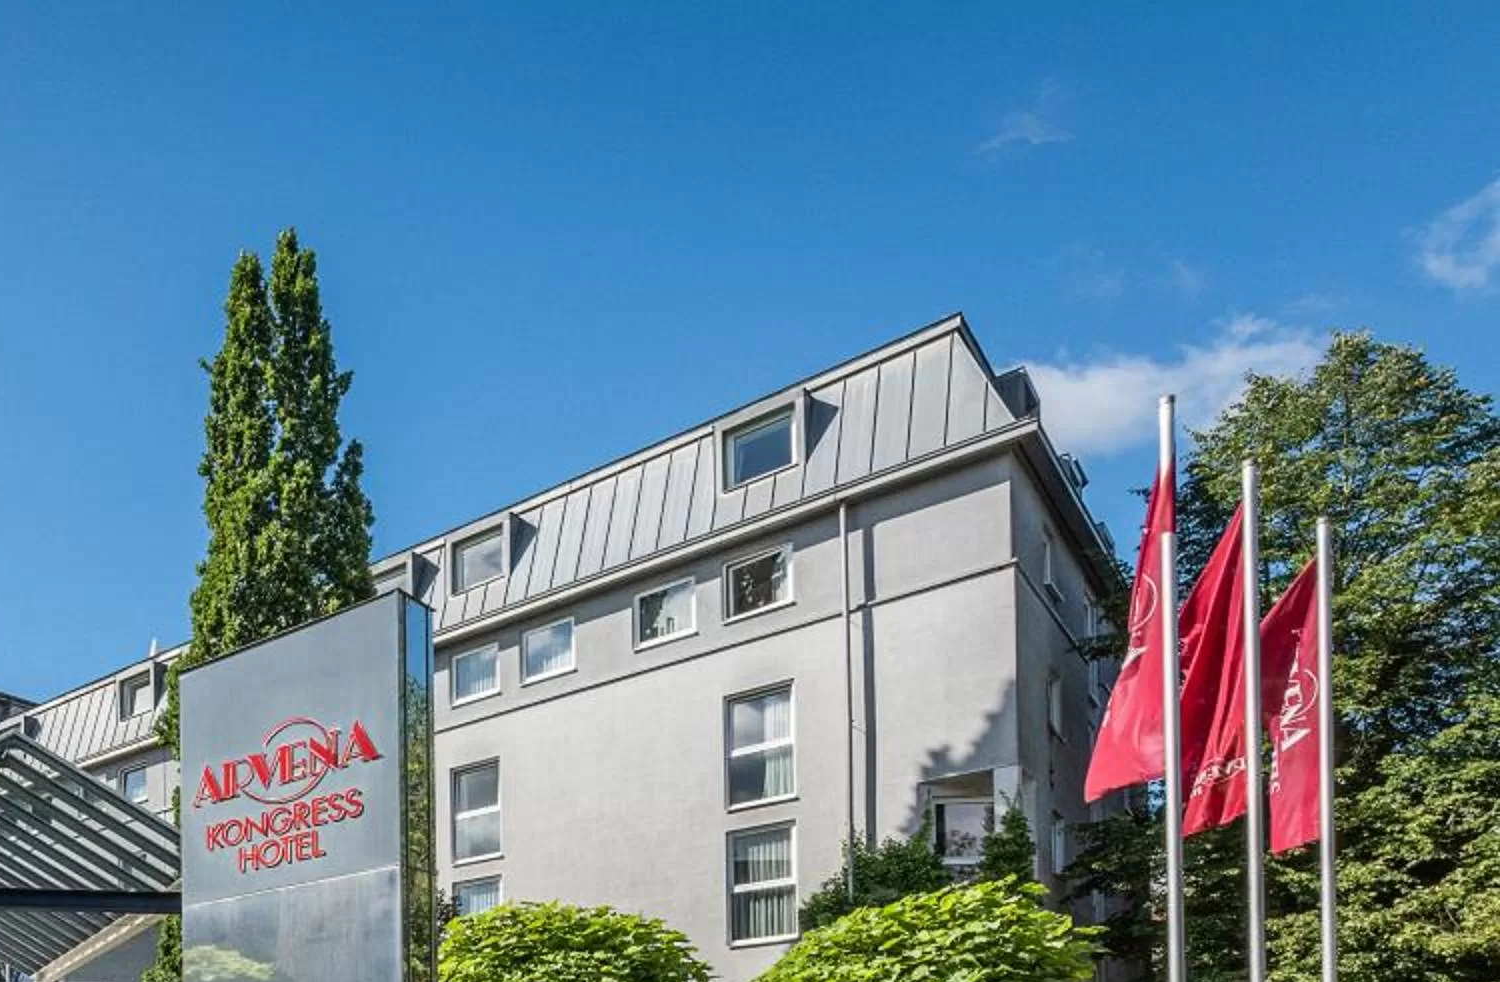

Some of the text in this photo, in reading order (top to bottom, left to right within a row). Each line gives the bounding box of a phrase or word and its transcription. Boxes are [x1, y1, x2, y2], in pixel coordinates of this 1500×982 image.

[194, 719, 383, 808] ARVENA
[206, 787, 365, 852] KONGRESS
[238, 830, 326, 874] HOTEL
